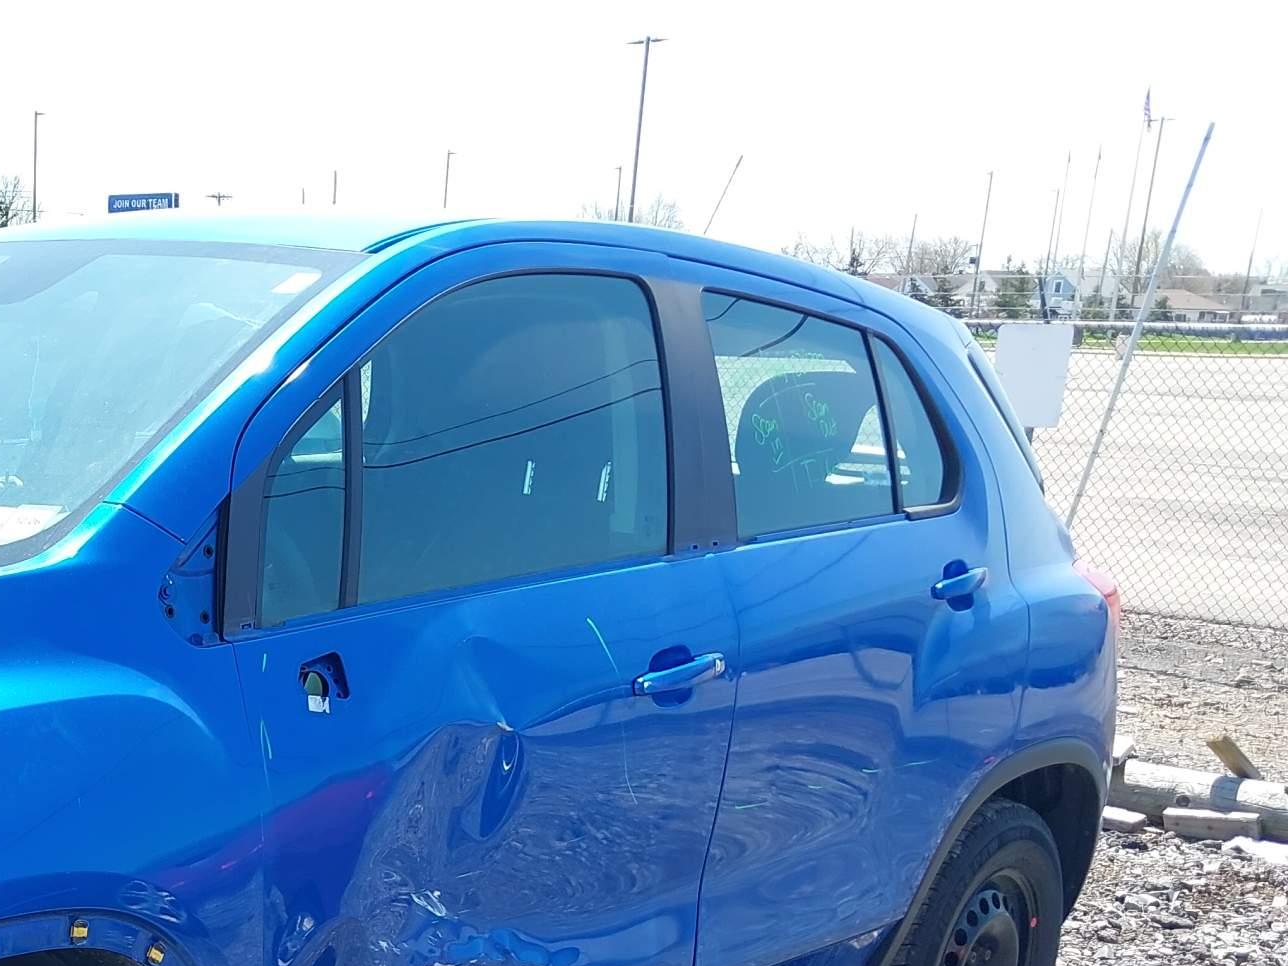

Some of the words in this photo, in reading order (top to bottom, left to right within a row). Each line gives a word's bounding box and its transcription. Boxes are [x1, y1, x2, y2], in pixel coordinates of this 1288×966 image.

[113, 199, 130, 209] JOIN
[131, 198, 147, 209] OUR
[148, 198, 169, 209] TEAM
